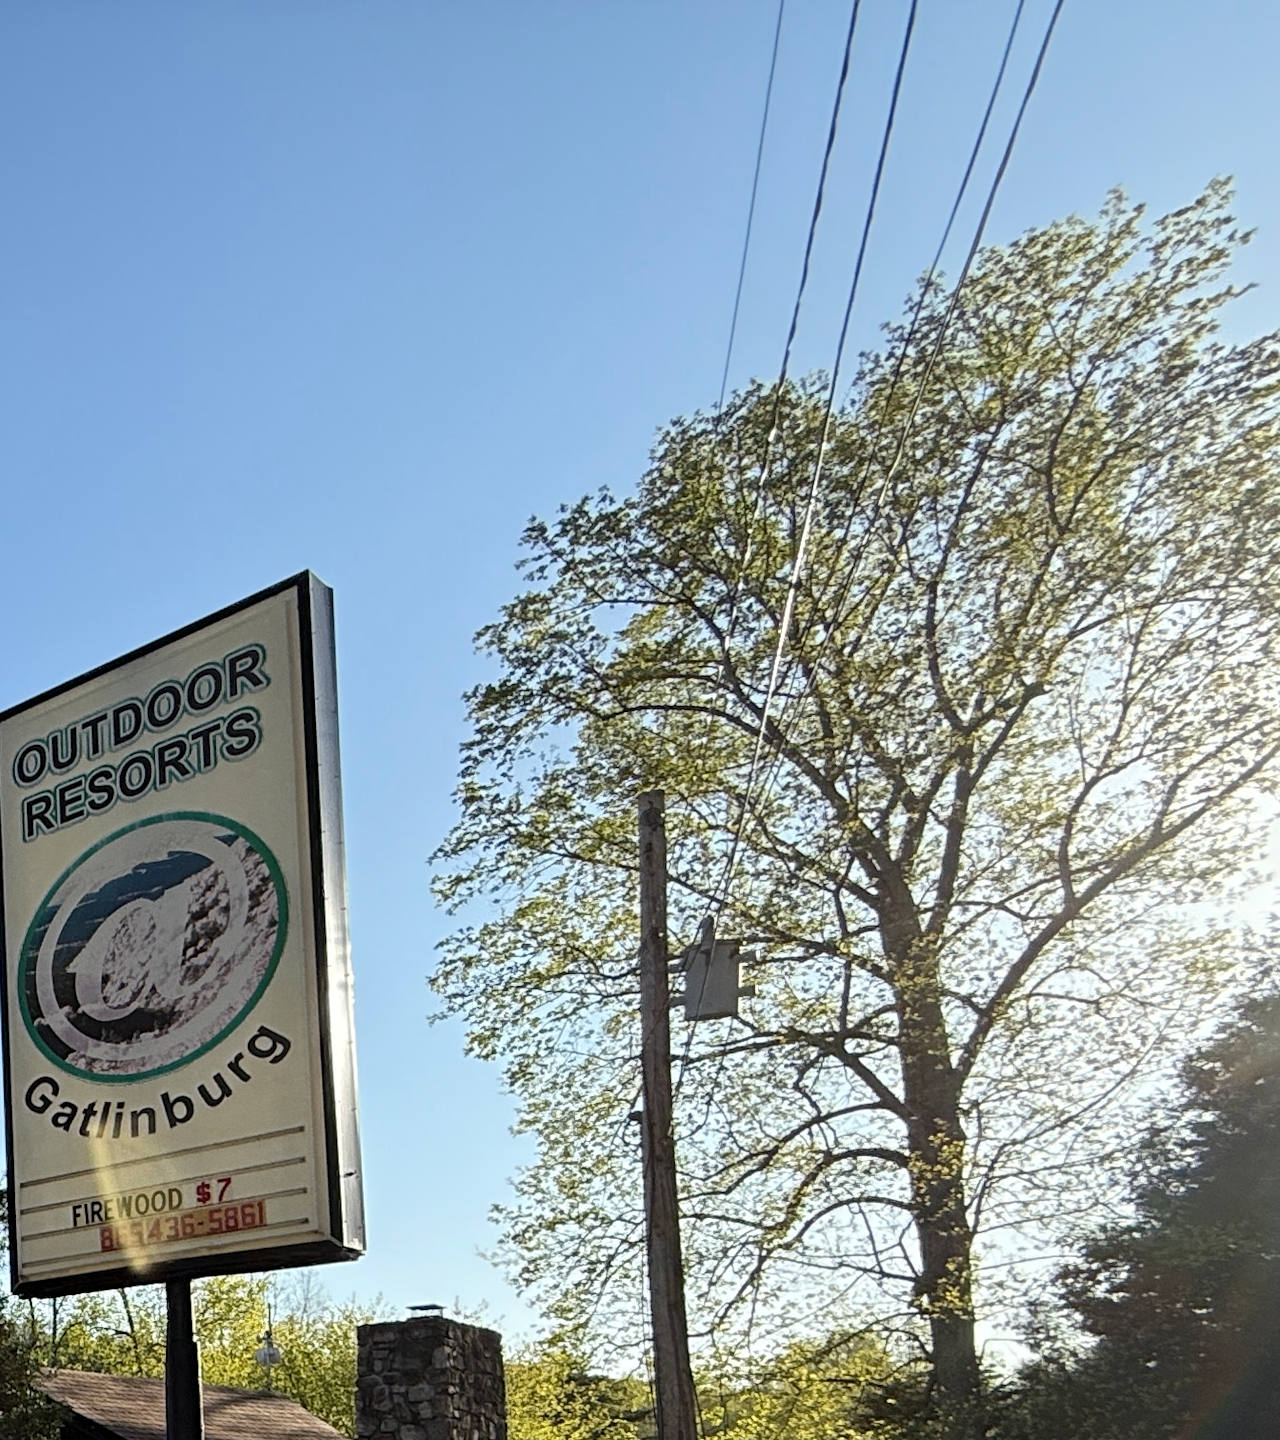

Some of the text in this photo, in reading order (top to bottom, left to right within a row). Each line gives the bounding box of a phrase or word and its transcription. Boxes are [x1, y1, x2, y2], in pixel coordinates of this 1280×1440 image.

[14, 644, 270, 788] OUTDOOR
[23, 707, 262, 842] RESORTS
[25, 1025, 291, 1139] Gatlinburg
[72, 1187, 183, 1227] FIREWOOD
